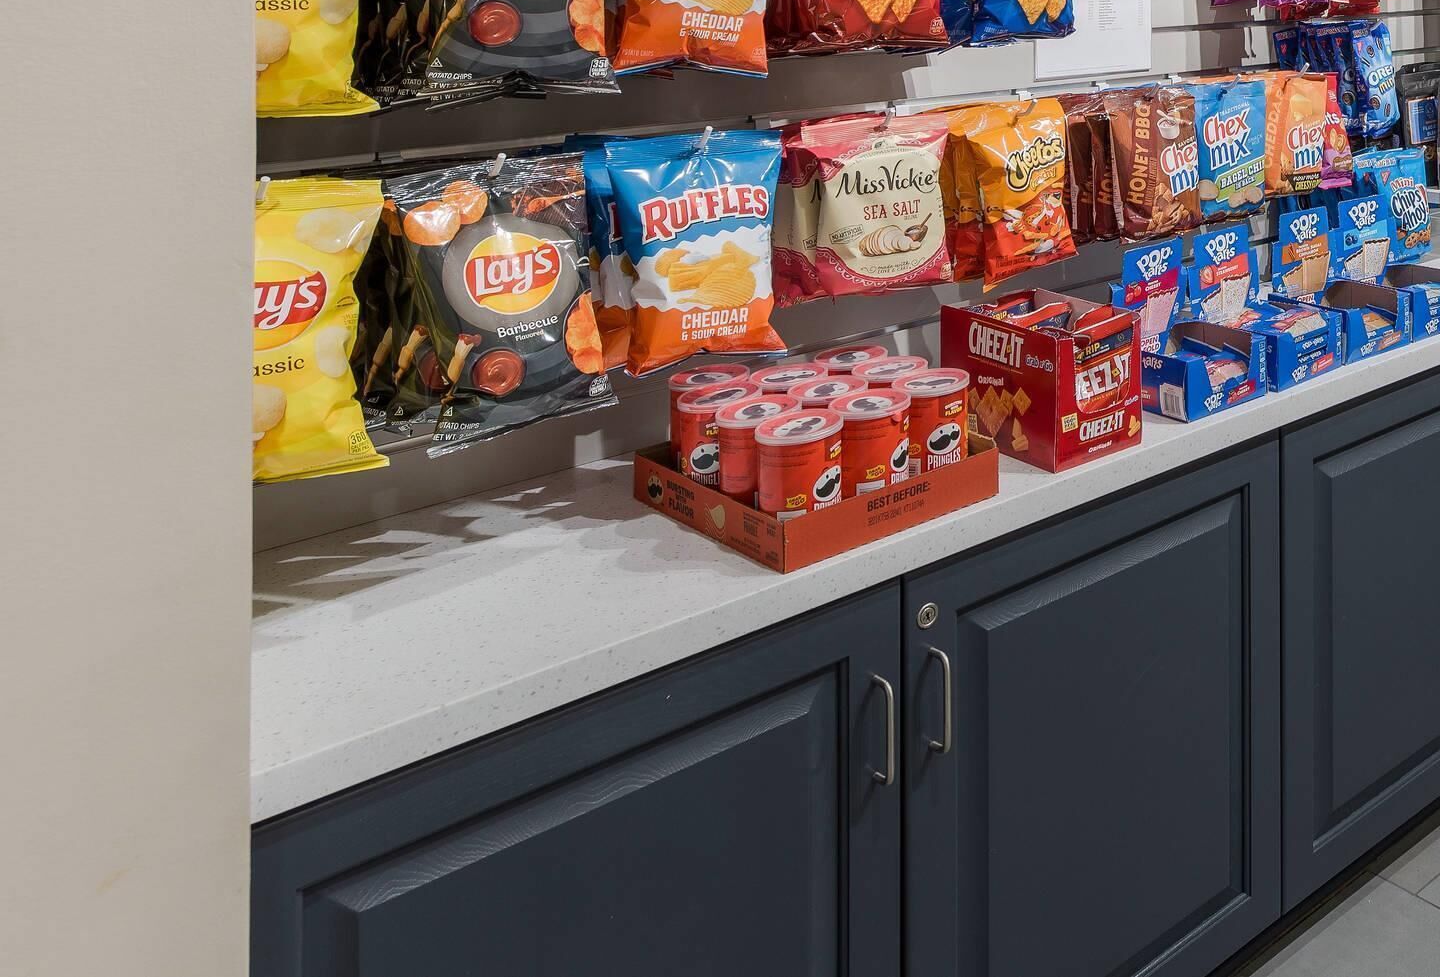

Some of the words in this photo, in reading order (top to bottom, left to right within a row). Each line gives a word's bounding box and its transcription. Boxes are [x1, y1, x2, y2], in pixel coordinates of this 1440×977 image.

[681, 11, 744, 33] CHEDDAR
[688, 29, 710, 40] SOUR
[711, 30, 740, 42] CREAM
[1204, 108, 1250, 146] Chex
[1325, 112, 1340, 125] its
[1287, 123, 1325, 151] Chex
[1006, 136, 1065, 192] Cheetos
[1126, 143, 1150, 205] HONEY
[836, 170, 885, 199] Miss
[1221, 167, 1247, 188] BAGEL
[1391, 178, 1414, 191] Mini
[642, 186, 768, 242] RUFFLES
[863, 204, 888, 221] SEA
[892, 198, 921, 217] SALT
[1392, 190, 1422, 218] Chips
[475, 246, 552, 296] Lay's
[254, 277, 321, 330] ay's
[496, 314, 559, 339] Barbecue
[681, 307, 749, 330] CHEDDAR
[515, 328, 545, 342] Flavored
[681, 331, 689, 341] &
[691, 328, 715, 341] SOUR
[717, 324, 748, 337] CREAM
[253, 356, 305, 377] assic
[459, 421, 480, 430] CHIPS
[350, 431, 366, 445] 360
[927, 447, 961, 471] PRINGLES
[691, 471, 720, 486] PRINGL
[668, 501, 695, 520] FLAVOR
[867, 494, 892, 513] BEST
